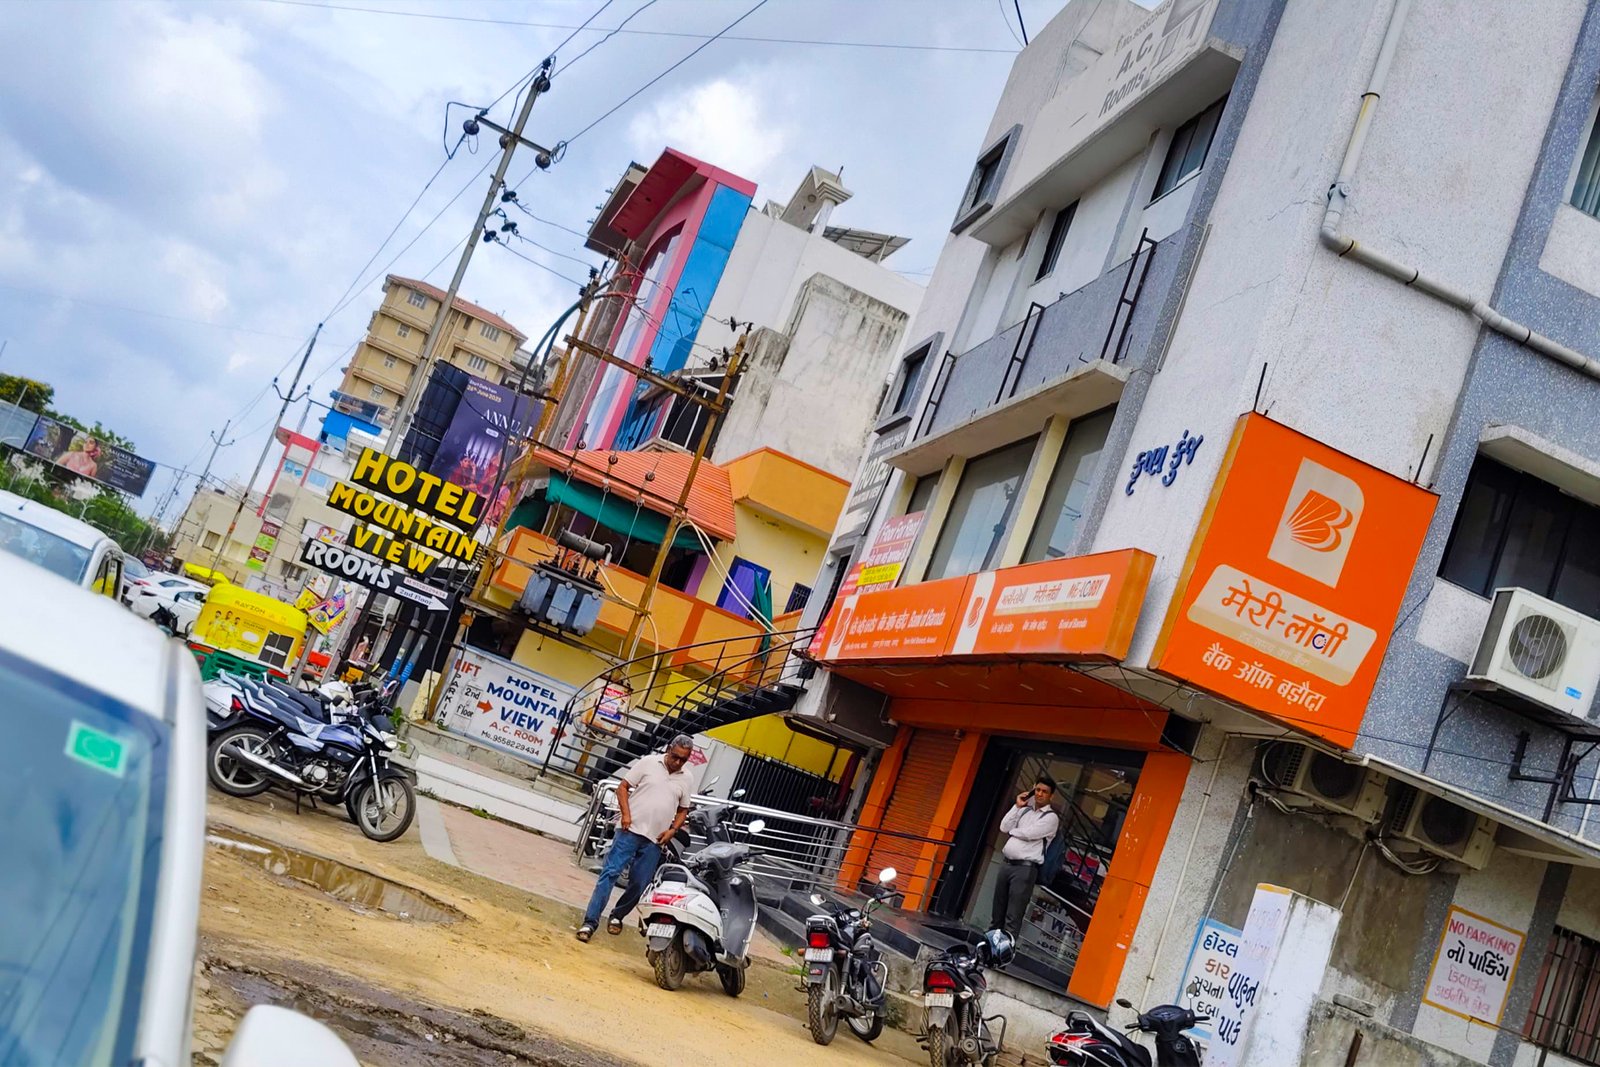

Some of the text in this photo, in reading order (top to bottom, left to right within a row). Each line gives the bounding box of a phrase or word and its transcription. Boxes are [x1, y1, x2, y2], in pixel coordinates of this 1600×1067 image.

[480, 408, 533, 440] ANNUL
[353, 447, 478, 525] HOTEL
[330, 482, 478, 561] MOUNTAIN
[353, 525, 435, 574] VIEW
[305, 540, 394, 590] ROOMS
[400, 588, 415, 599] 2nd
[454, 659, 482, 677] LIFT
[1201, 641, 1235, 672] बैंक
[436, 672, 462, 727] PARKING
[464, 687, 481, 700] 2nd
[507, 676, 558, 701] HOTEL
[489, 721, 512, 735] A.C.
[499, 707, 544, 732] VIEW
[1447, 938, 1465, 961] નો
[1448, 918, 1517, 956] NO PARKING
[1205, 957, 1230, 981] કાર
